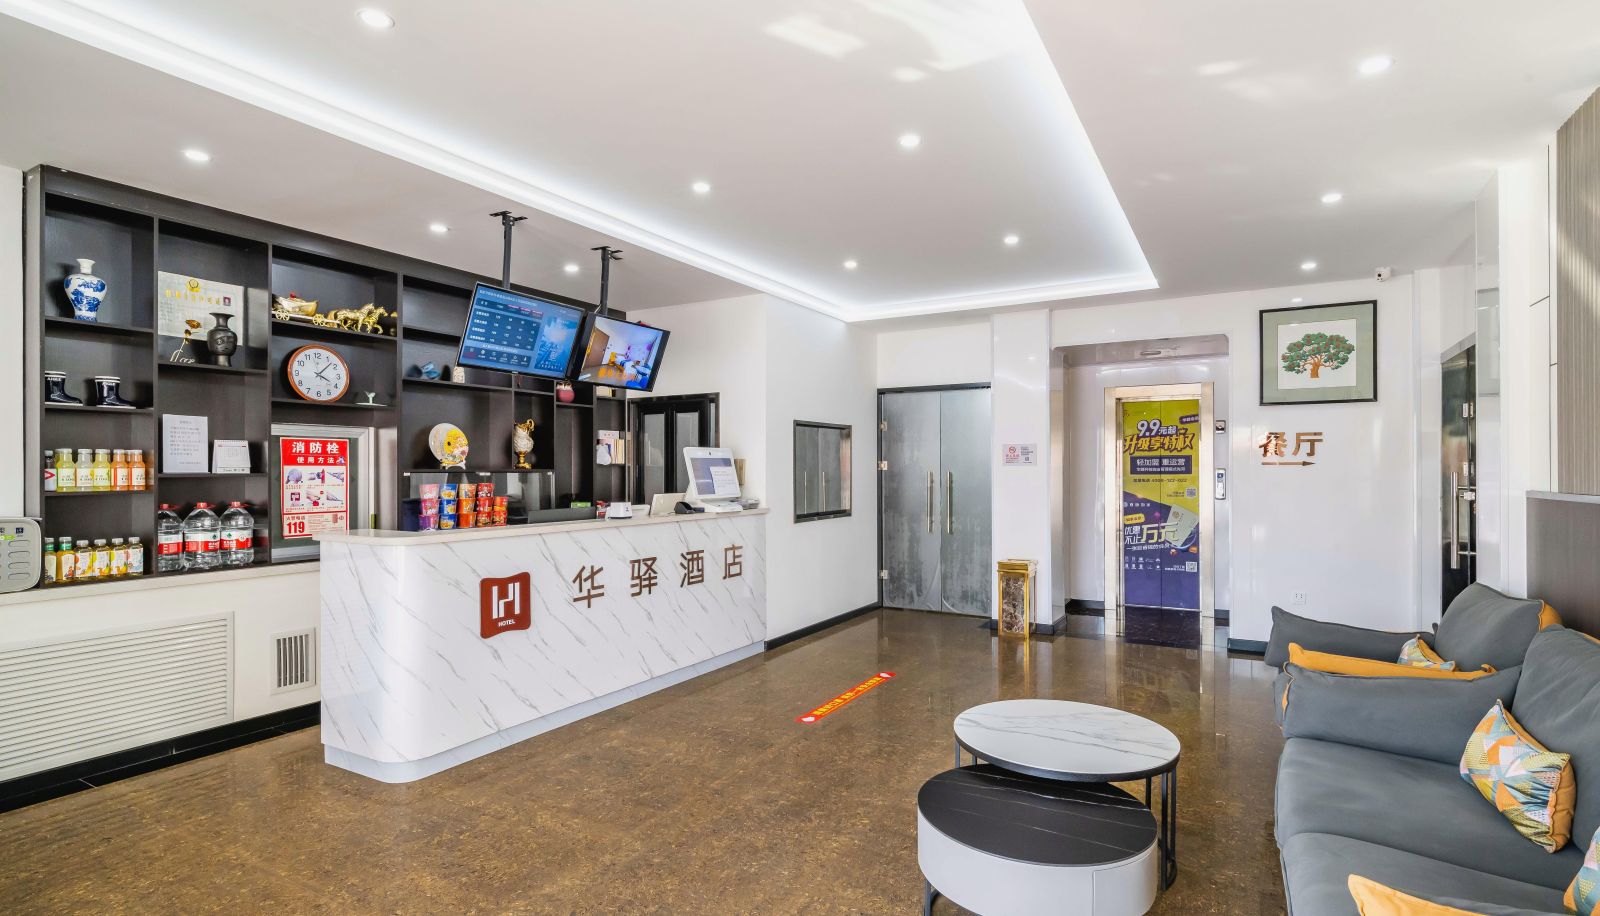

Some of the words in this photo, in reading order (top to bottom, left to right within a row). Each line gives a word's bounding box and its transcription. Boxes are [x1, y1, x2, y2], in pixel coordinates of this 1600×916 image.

[1137, 419, 1177, 437] 9.9元起
[292, 441, 340, 454] 消防栓
[1123, 433, 1194, 454] 升级享特权
[1259, 431, 1324, 457] 餐厅
[296, 456, 335, 464] 使用方法
[286, 521, 305, 534] 119
[1140, 521, 1180, 544] 万元
[572, 544, 743, 608] 华驿酒店
[498, 619, 516, 627] HOTEL
